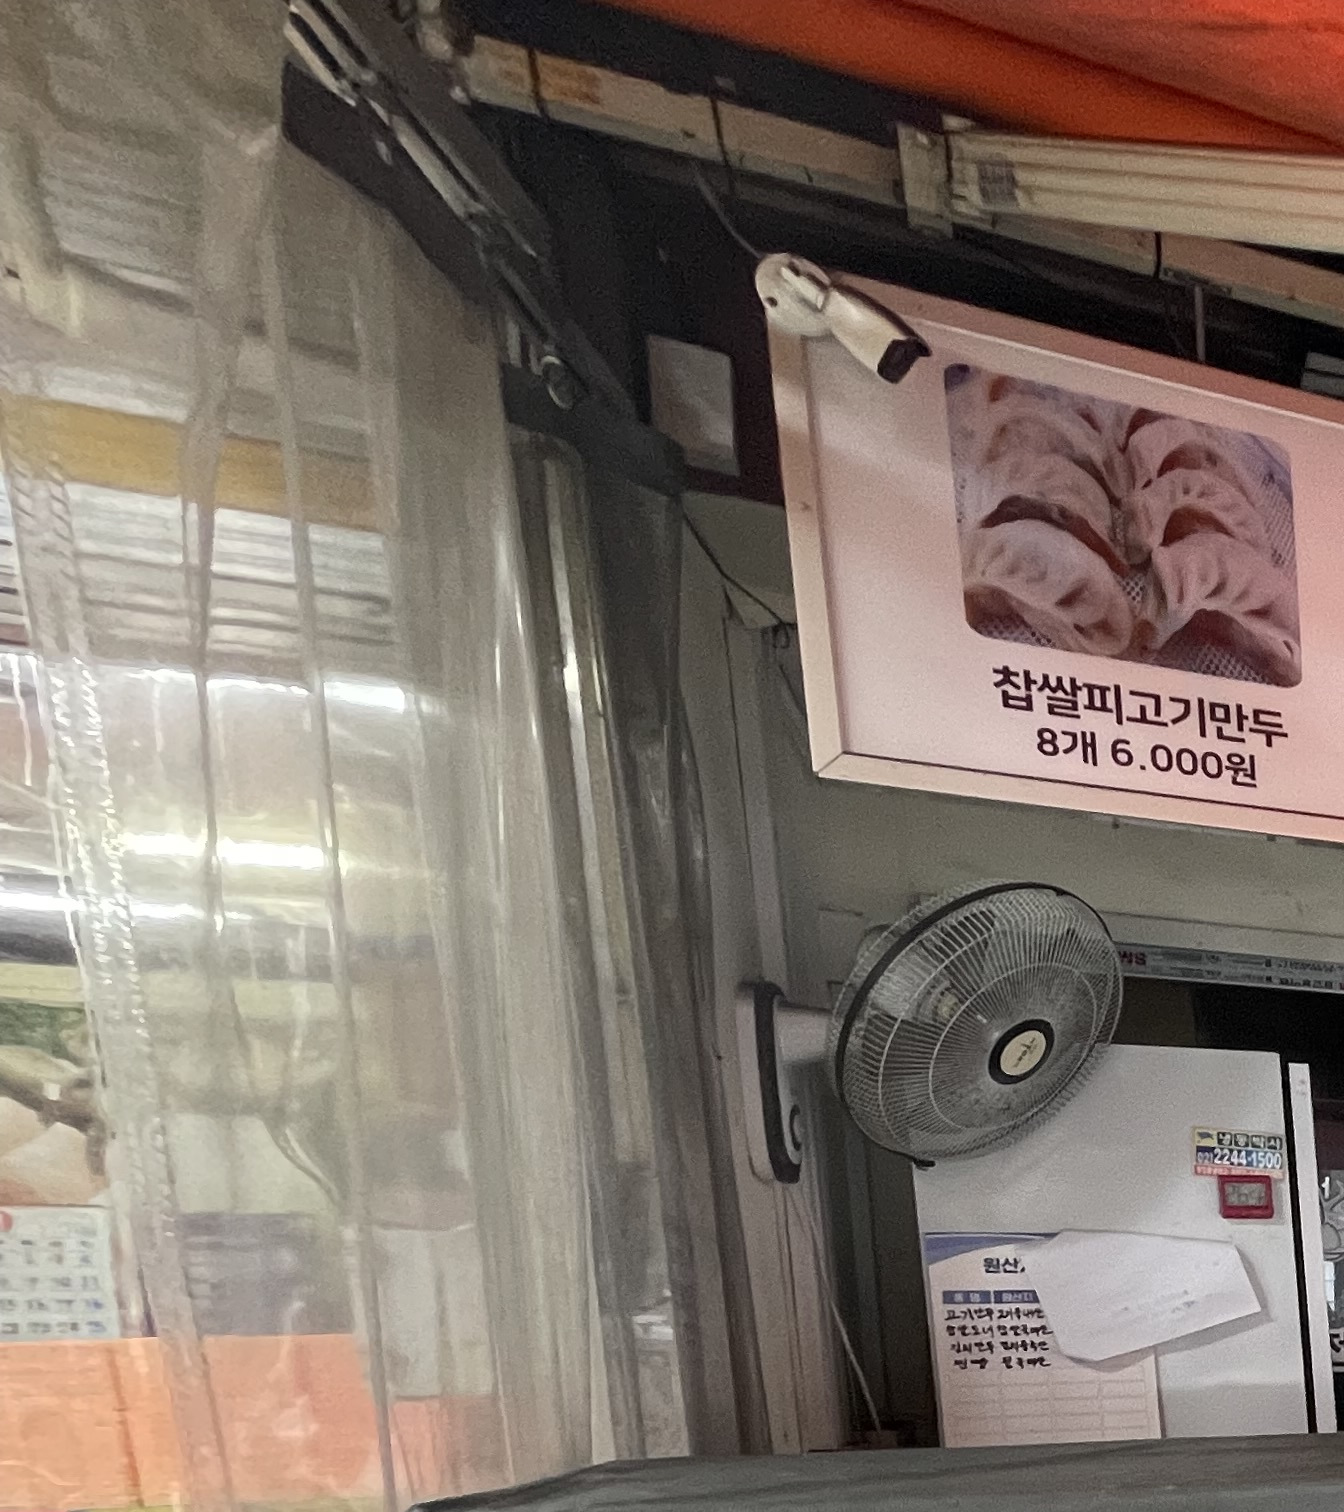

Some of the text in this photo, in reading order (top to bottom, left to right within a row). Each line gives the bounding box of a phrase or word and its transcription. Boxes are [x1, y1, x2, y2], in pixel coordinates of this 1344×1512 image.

[993, 665, 1288, 748] 찹쌀피고기만두
[1037, 727, 1258, 789] 8개 6.000원
[984, 1257, 1026, 1274] 원산
